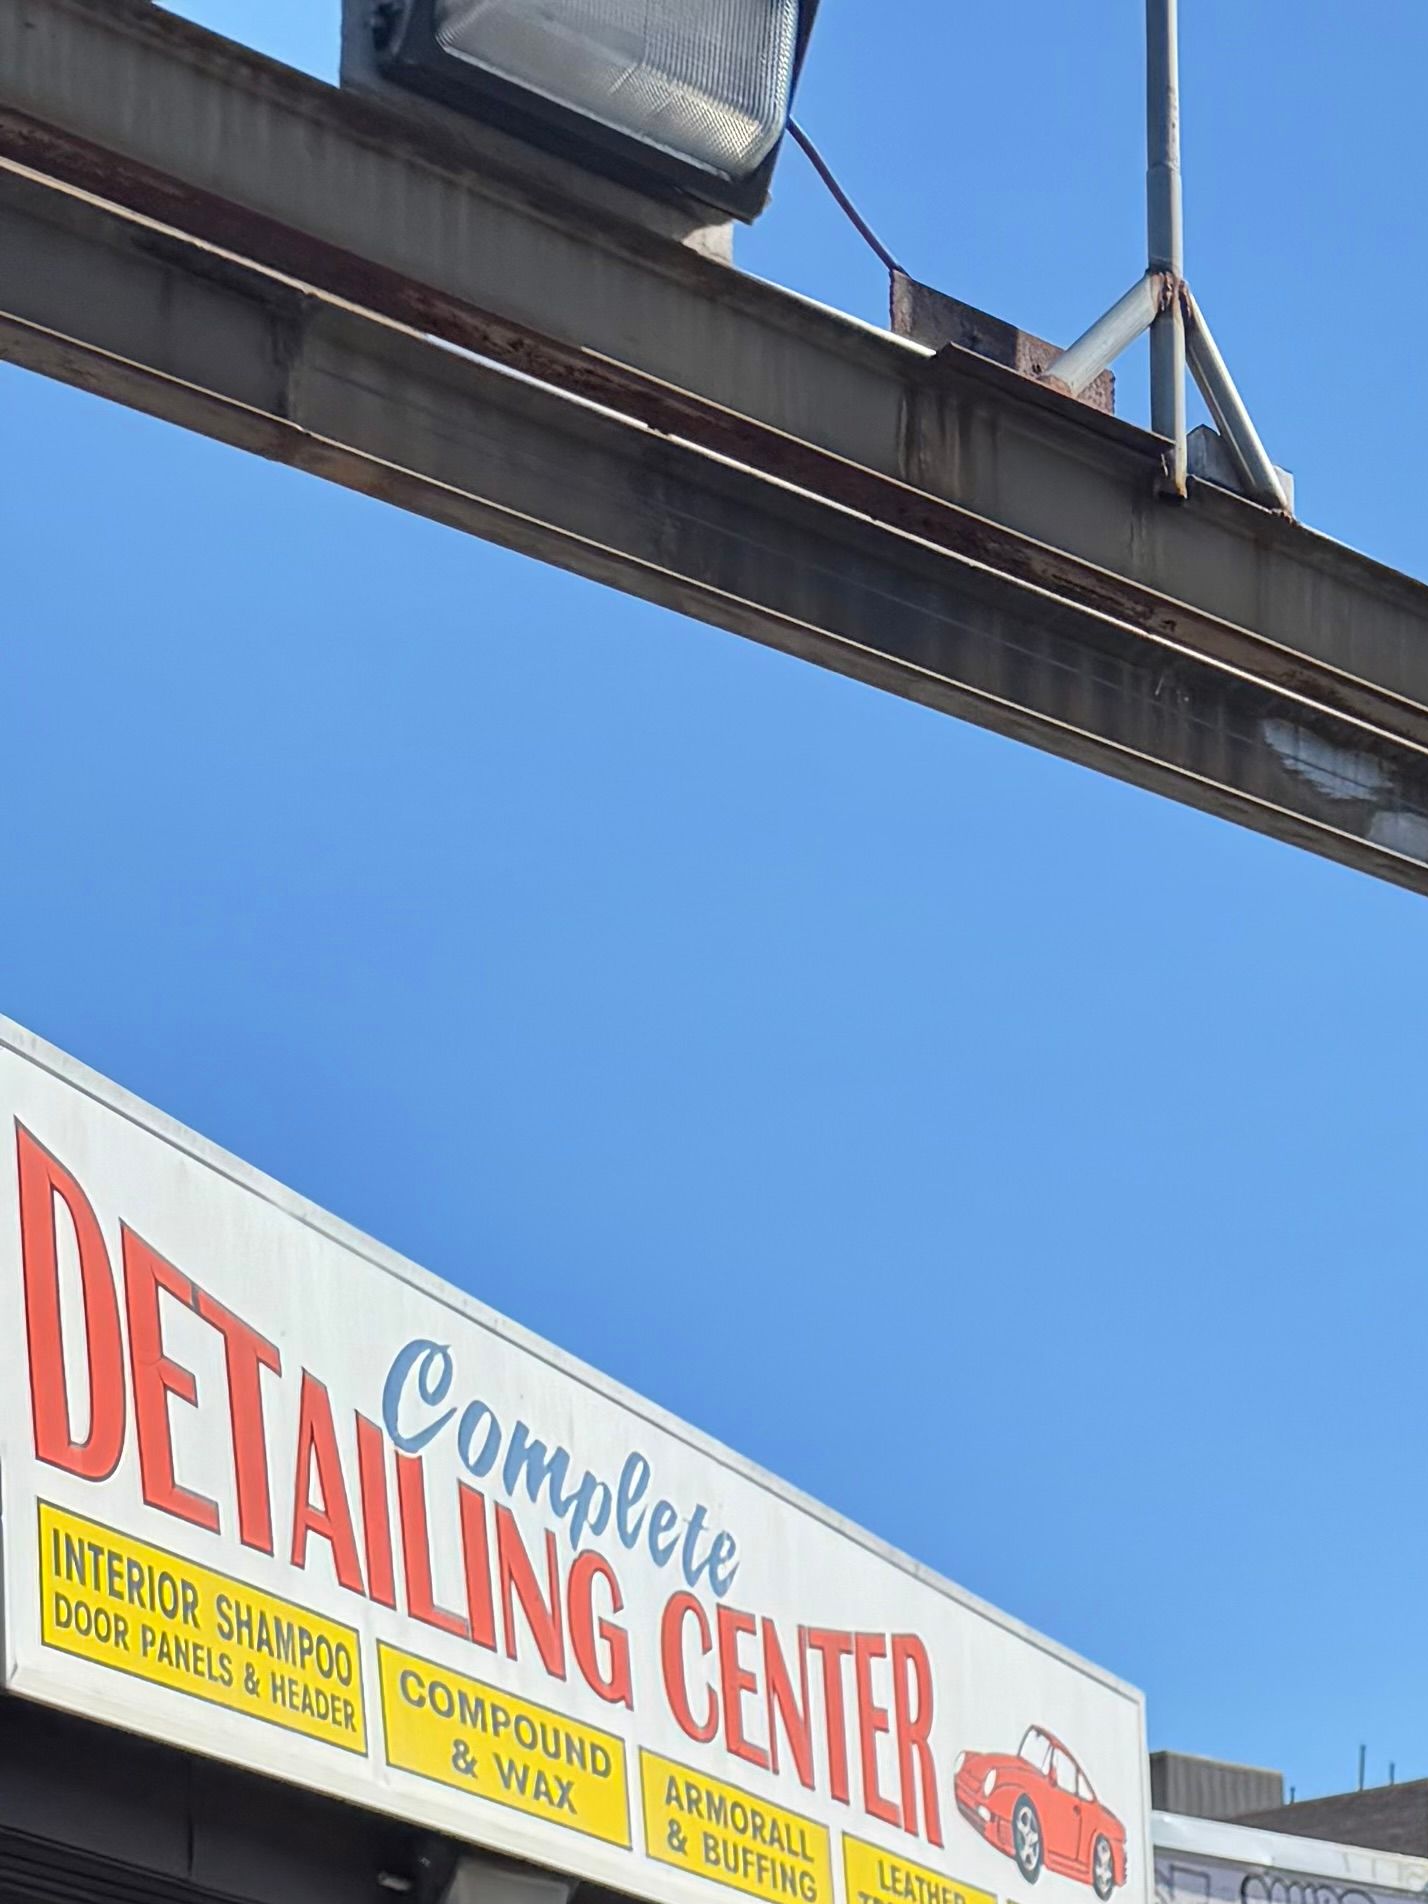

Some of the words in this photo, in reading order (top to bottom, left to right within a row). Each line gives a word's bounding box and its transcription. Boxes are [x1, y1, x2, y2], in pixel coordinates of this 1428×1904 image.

[14, 1114, 634, 1711] DETAILING
[661, 1590, 944, 1849] CENTER
[383, 1339, 740, 1597] Complete
[53, 1528, 200, 1629] INTERIOR
[216, 1594, 352, 1688] SHAMPOO
[54, 1592, 129, 1652] DOOR
[141, 1624, 234, 1688] PANELS
[244, 1662, 260, 1698] &
[271, 1671, 357, 1733] HEADER
[400, 1669, 612, 1779] COMPOUND
[451, 1738, 478, 1779] &
[493, 1751, 578, 1815] WAX
[665, 1775, 815, 1863] ARMORALL
[667, 1818, 689, 1856] &
[703, 1834, 818, 1903] BUFFING
